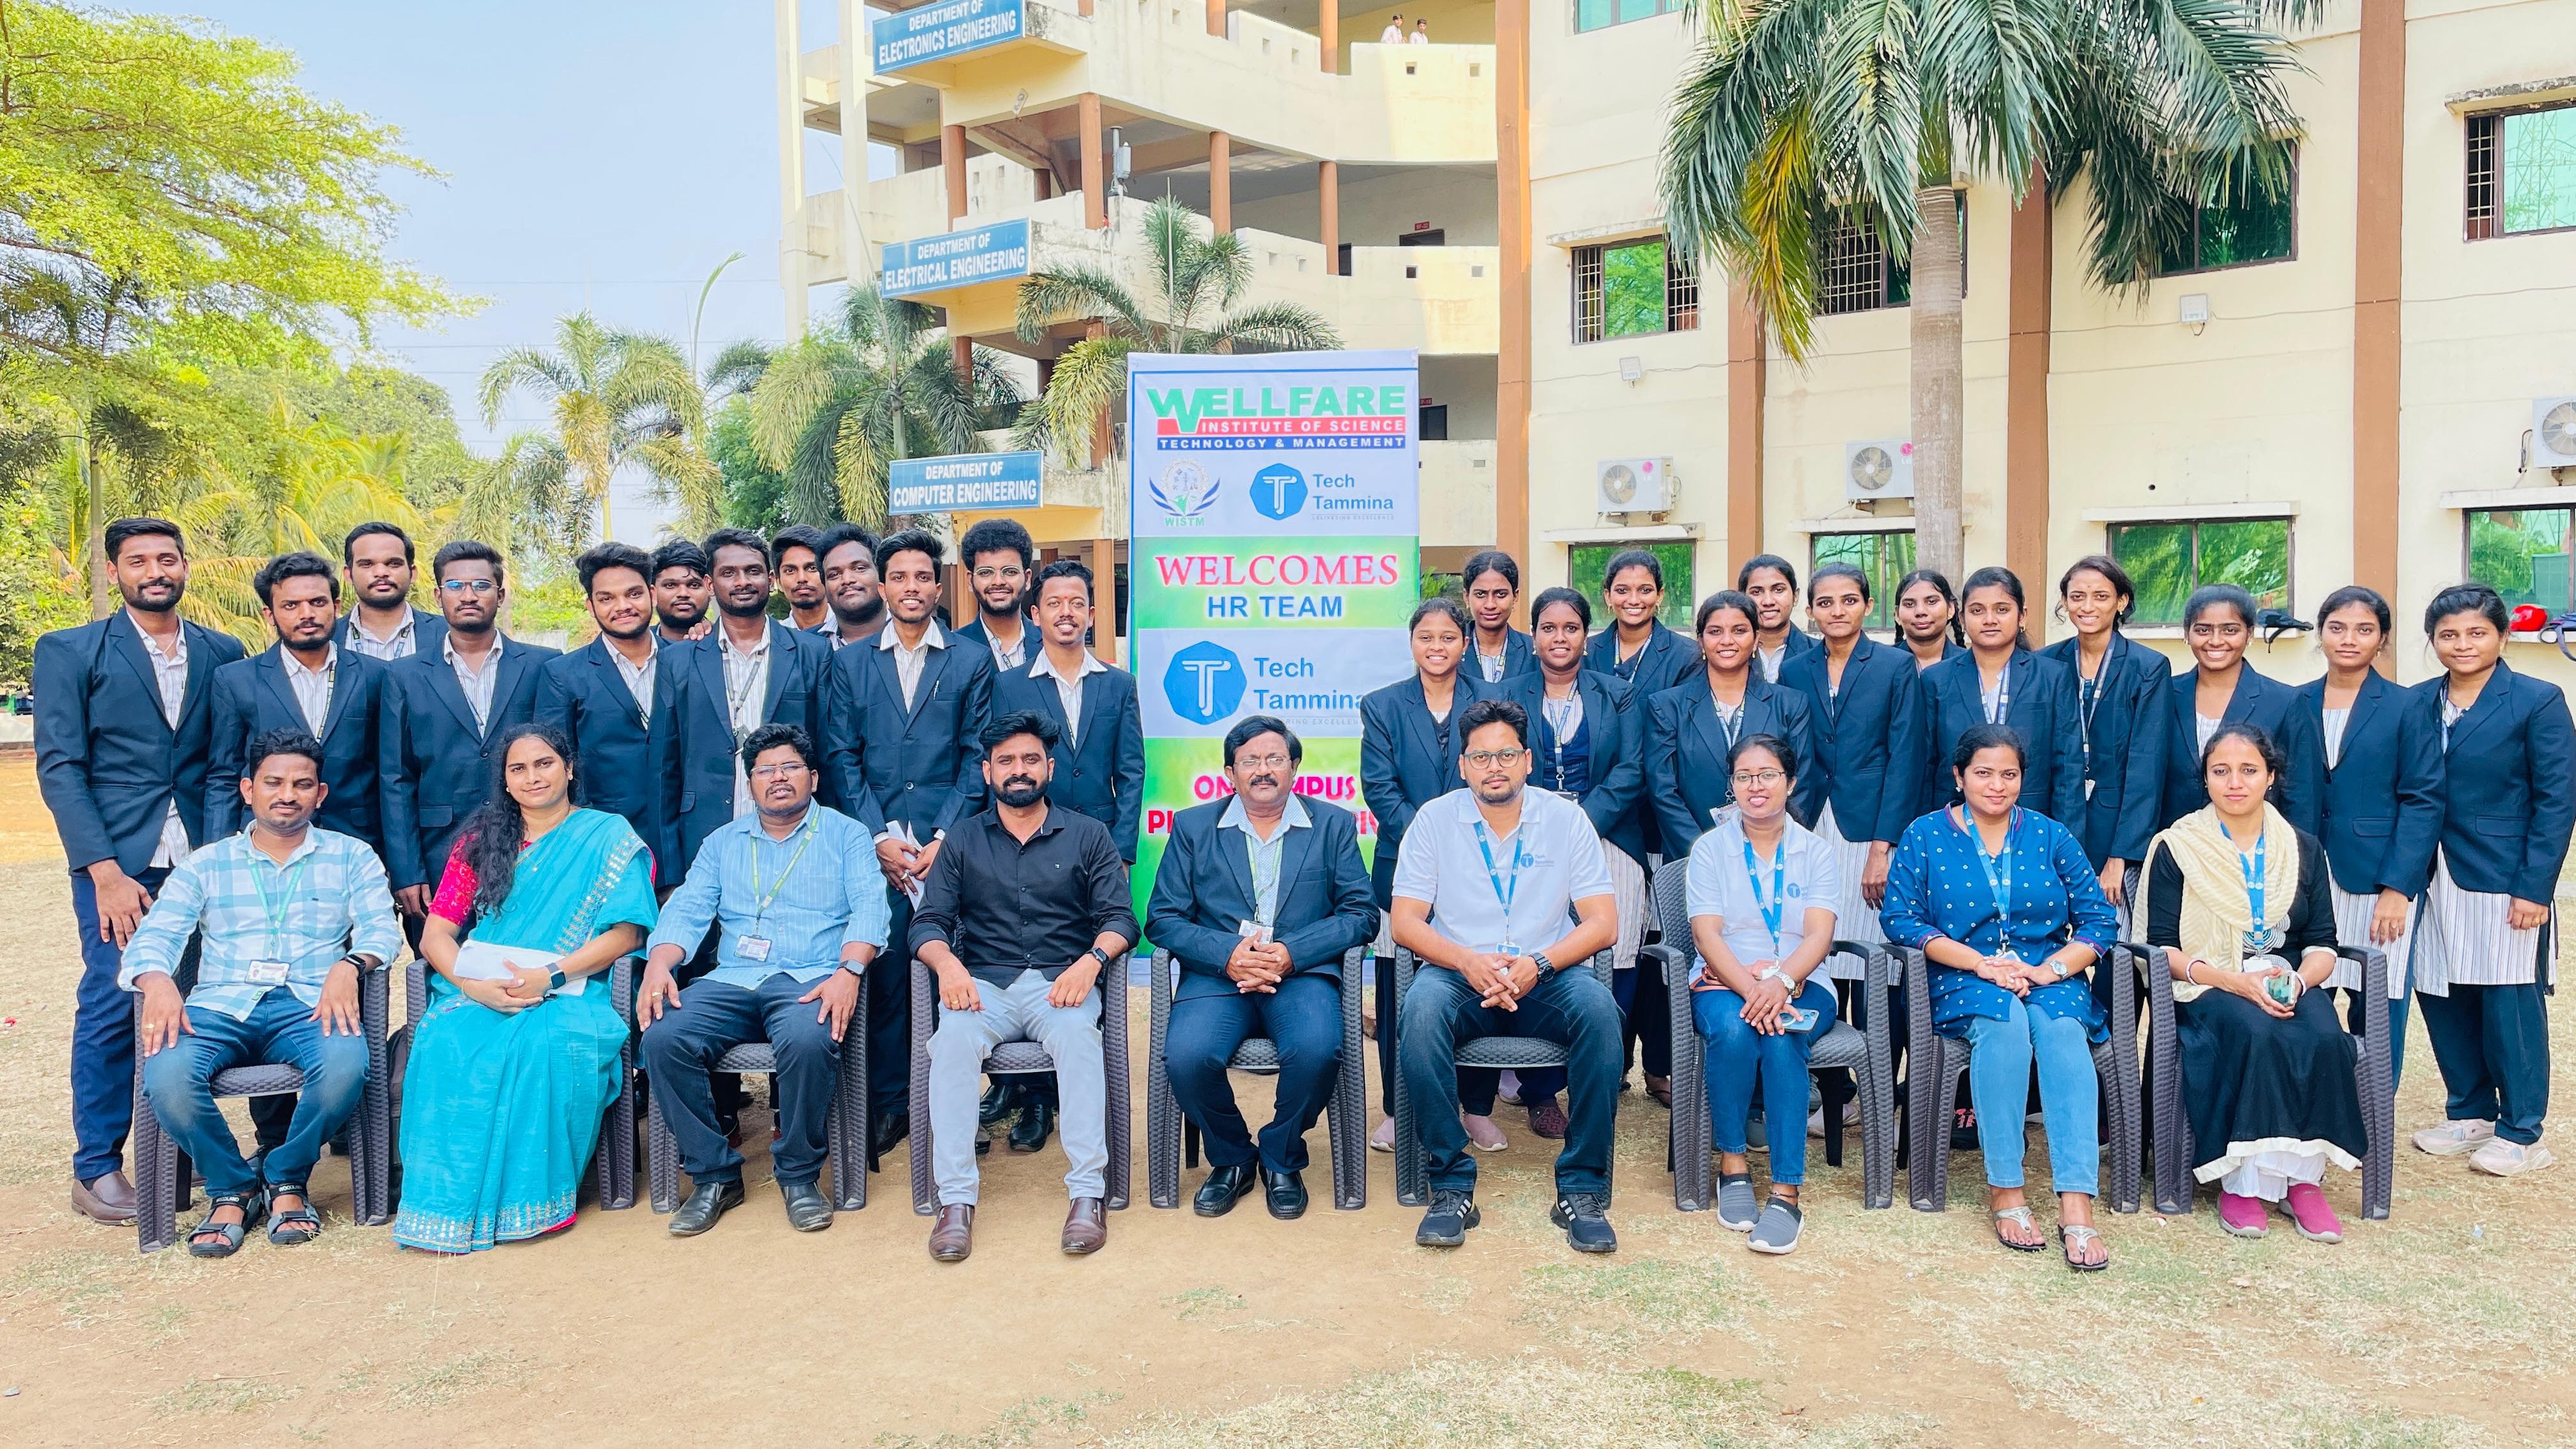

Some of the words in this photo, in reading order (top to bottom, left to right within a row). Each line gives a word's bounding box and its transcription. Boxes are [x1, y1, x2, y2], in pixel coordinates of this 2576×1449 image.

[909, 2, 969, 31] DEPARTMENT
[970, 0, 983, 14] OF
[879, 29, 945, 65] ELECTRONICS
[947, 10, 1016, 47] ENGINEERING
[918, 235, 977, 260] DEPARTMENT
[979, 233, 990, 249] OF
[885, 261, 948, 291] ELECTRICAL
[950, 247, 1025, 279] ENGINEERING
[1146, 386, 1406, 433] WELLFARE
[1202, 420, 1292, 433] INSTITUTE
[1301, 420, 1321, 433] OF
[1330, 419, 1404, 432] SCIENCE
[1160, 438, 1267, 449] TECHNOLOGY
[1275, 438, 1284, 448] &
[1292, 437, 1405, 448] MANAGEMENT
[926, 462, 988, 480] DEPARTMENT
[990, 461, 1004, 476] OF
[1313, 473, 1354, 488] Tech
[894, 484, 954, 507] COMPUTER
[957, 479, 1036, 503] ENGINEERING
[1313, 494, 1394, 510] Tammina
[1165, 517, 1204, 527] WISTM
[1155, 555, 1399, 586] WELCOMES
[1208, 596, 1248, 618] HR
[1259, 595, 1342, 618] TEAM
[1254, 657, 1314, 678] Tech
[1254, 689, 1362, 710] Tammina
